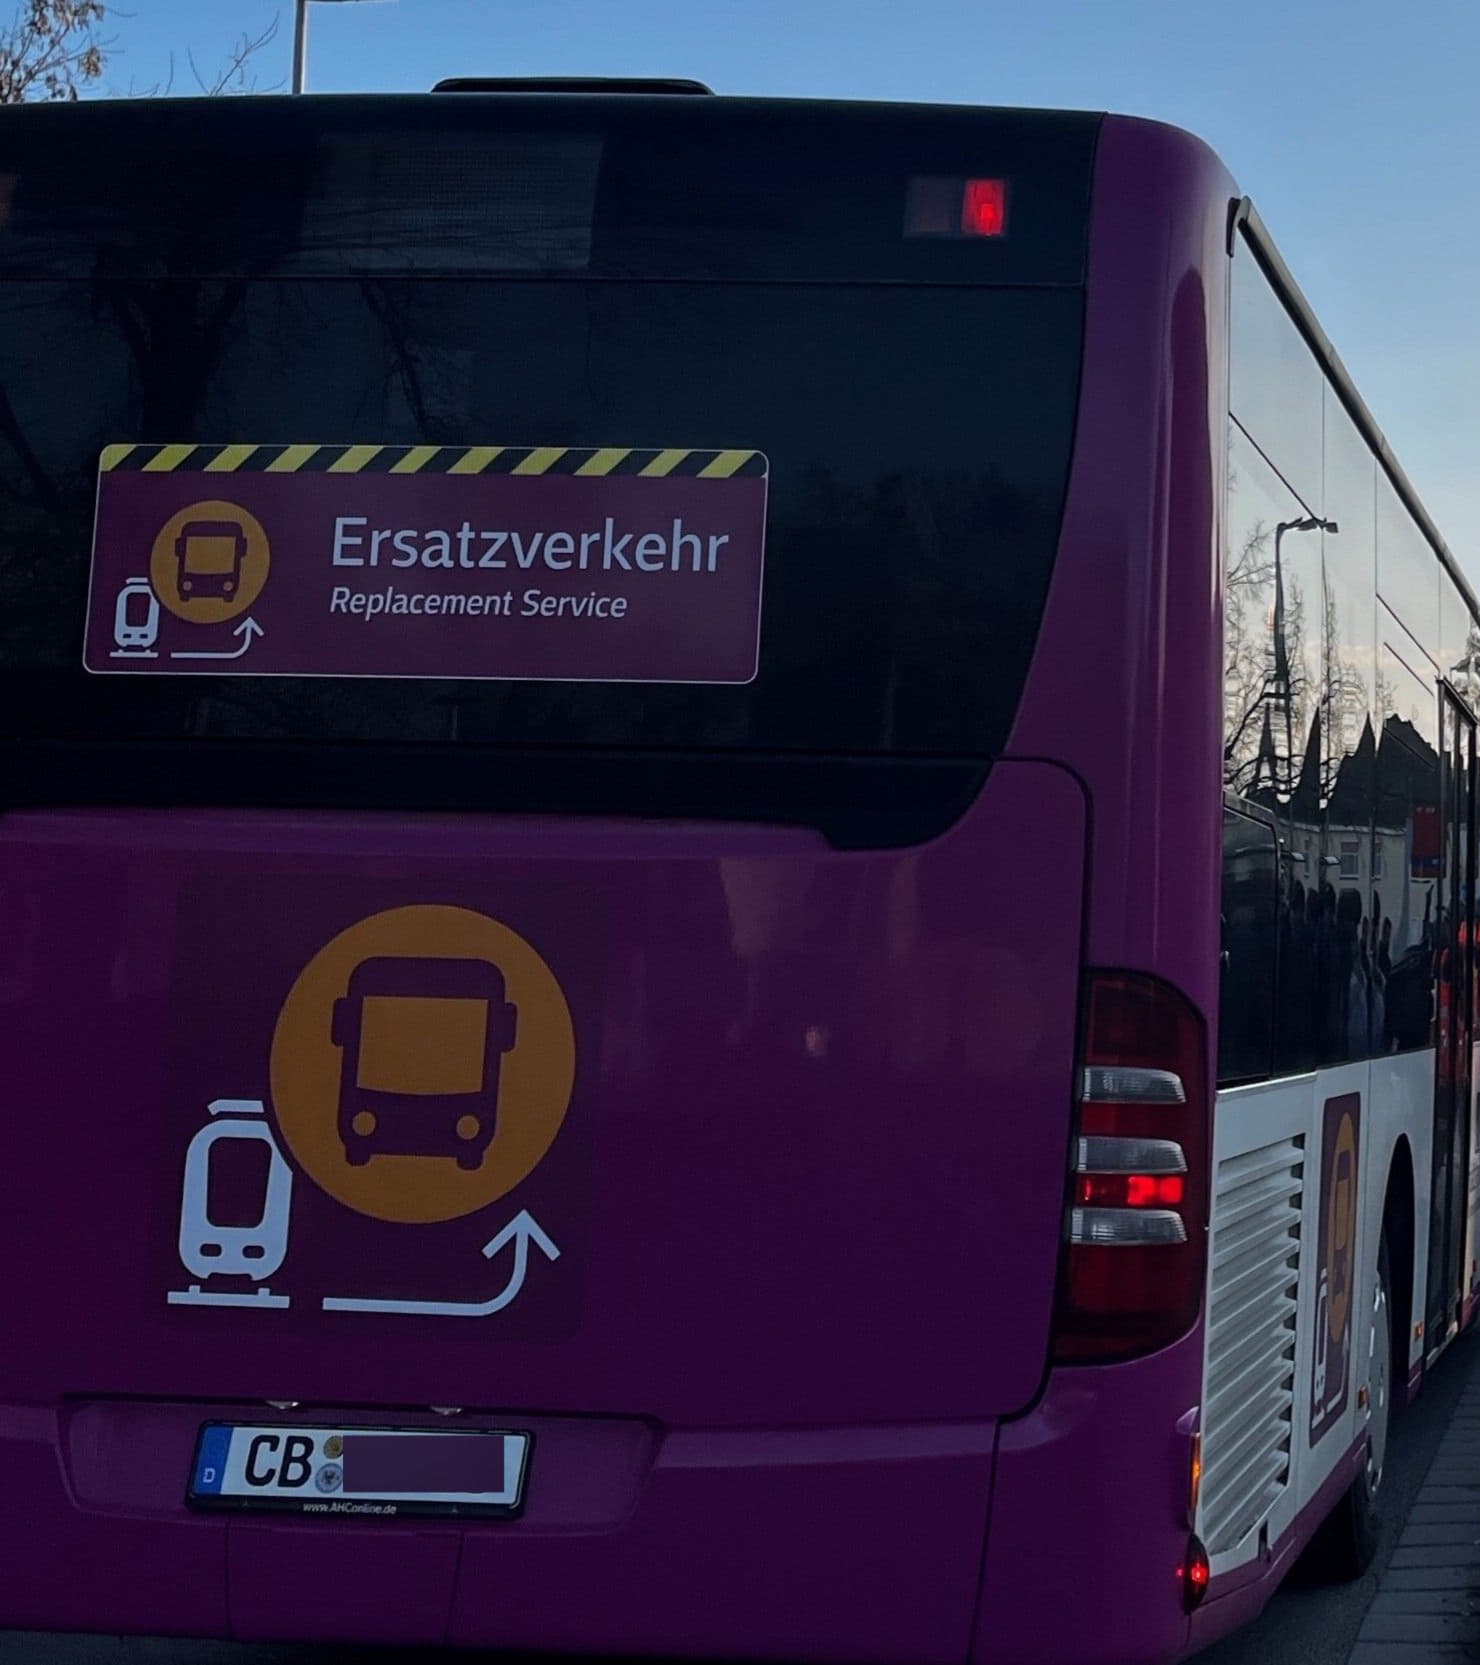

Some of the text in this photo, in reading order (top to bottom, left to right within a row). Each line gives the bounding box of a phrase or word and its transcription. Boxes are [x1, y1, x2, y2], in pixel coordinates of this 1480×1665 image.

[332, 517, 730, 572] Ersatzverkehr
[330, 585, 628, 622] Replacement Service
[202, 1434, 315, 1488] D CB
[303, 1501, 398, 1515] www.AHConline.de
